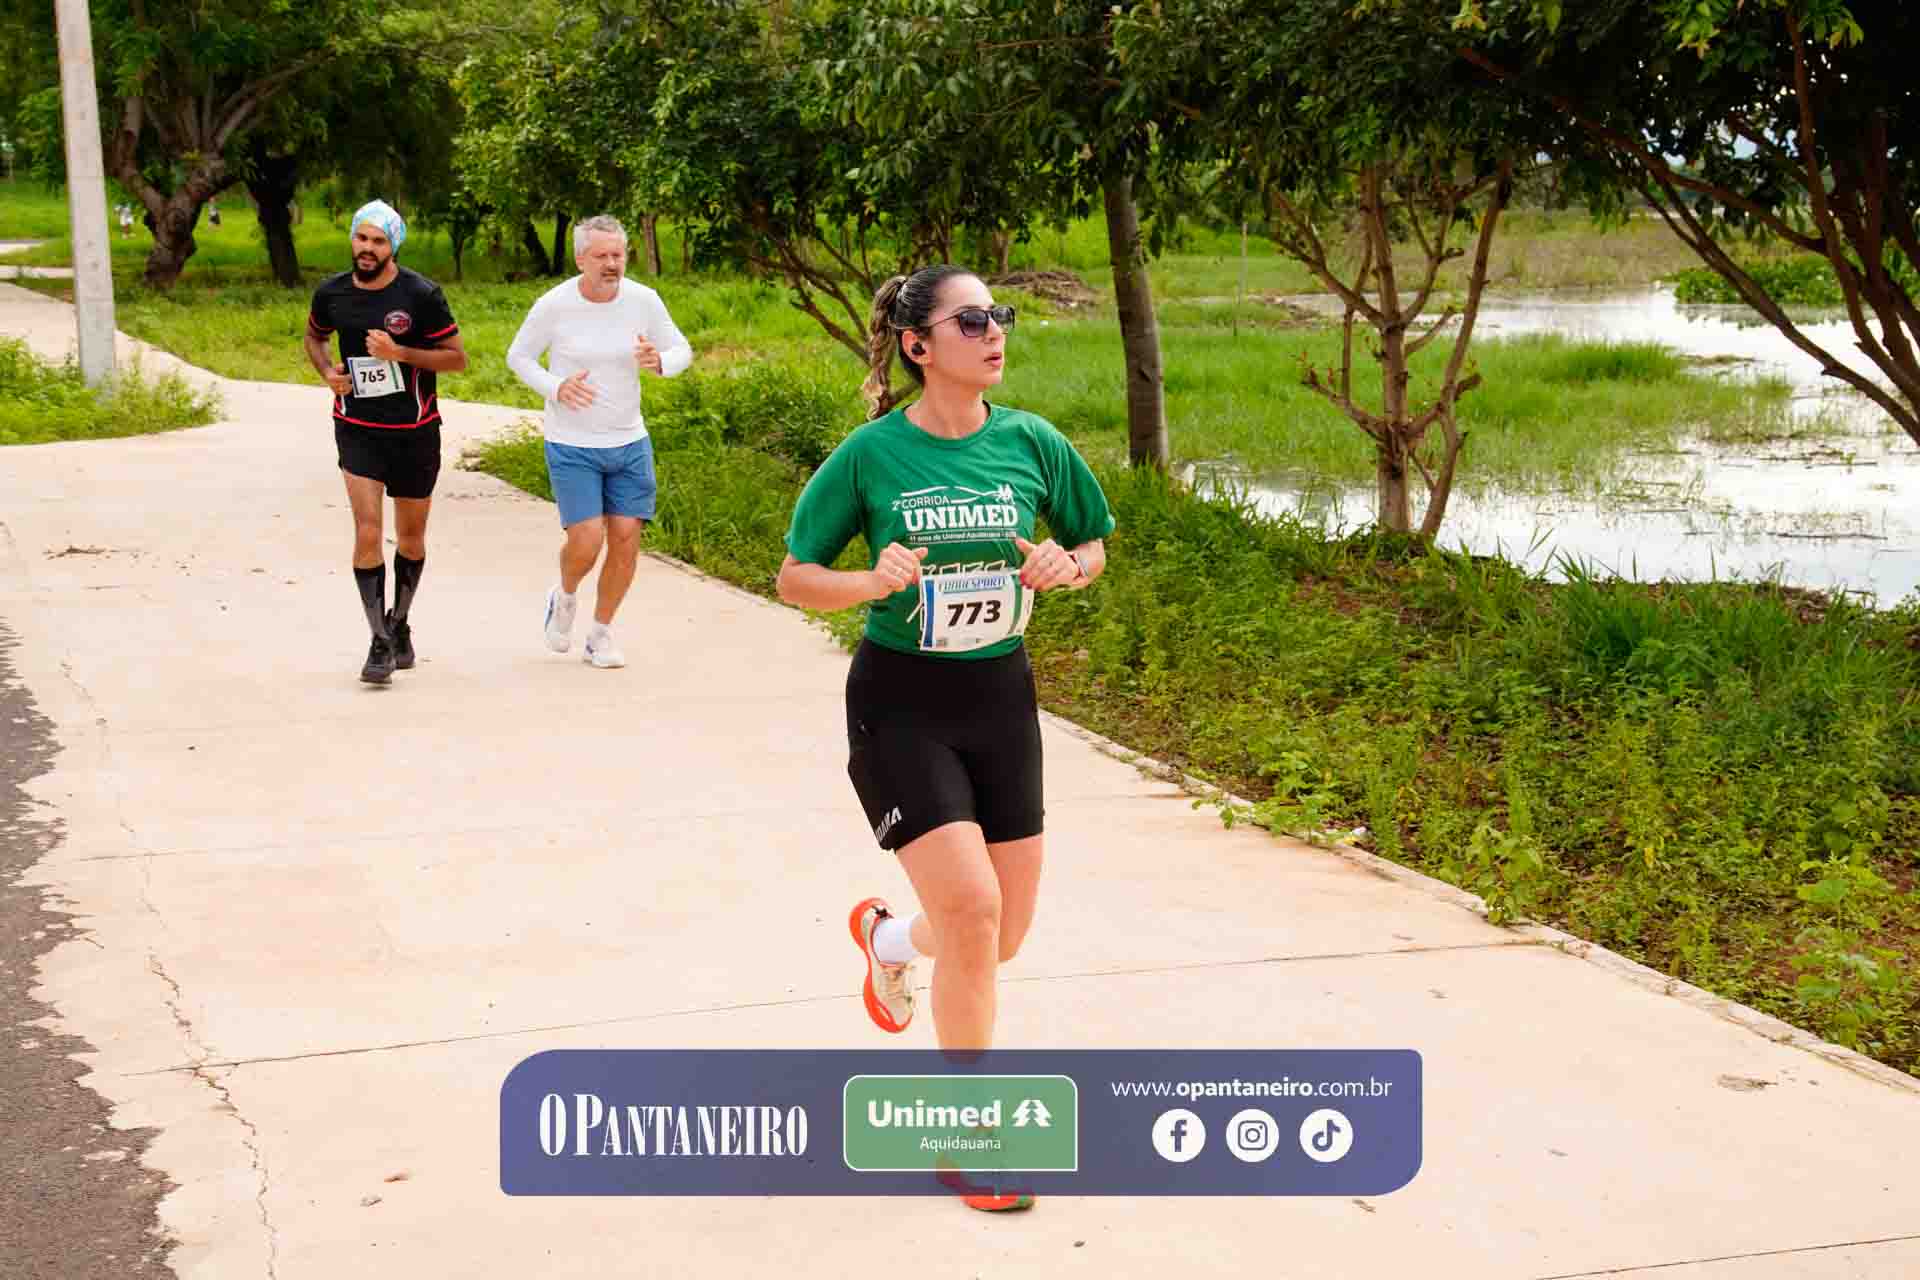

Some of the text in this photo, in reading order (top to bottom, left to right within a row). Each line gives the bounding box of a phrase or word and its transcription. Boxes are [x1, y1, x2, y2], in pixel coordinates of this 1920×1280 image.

[360, 369, 386, 383] 765
[901, 495, 951, 510] CORRIDA
[902, 504, 1018, 532] UNIMED
[947, 600, 1001, 628] 773
